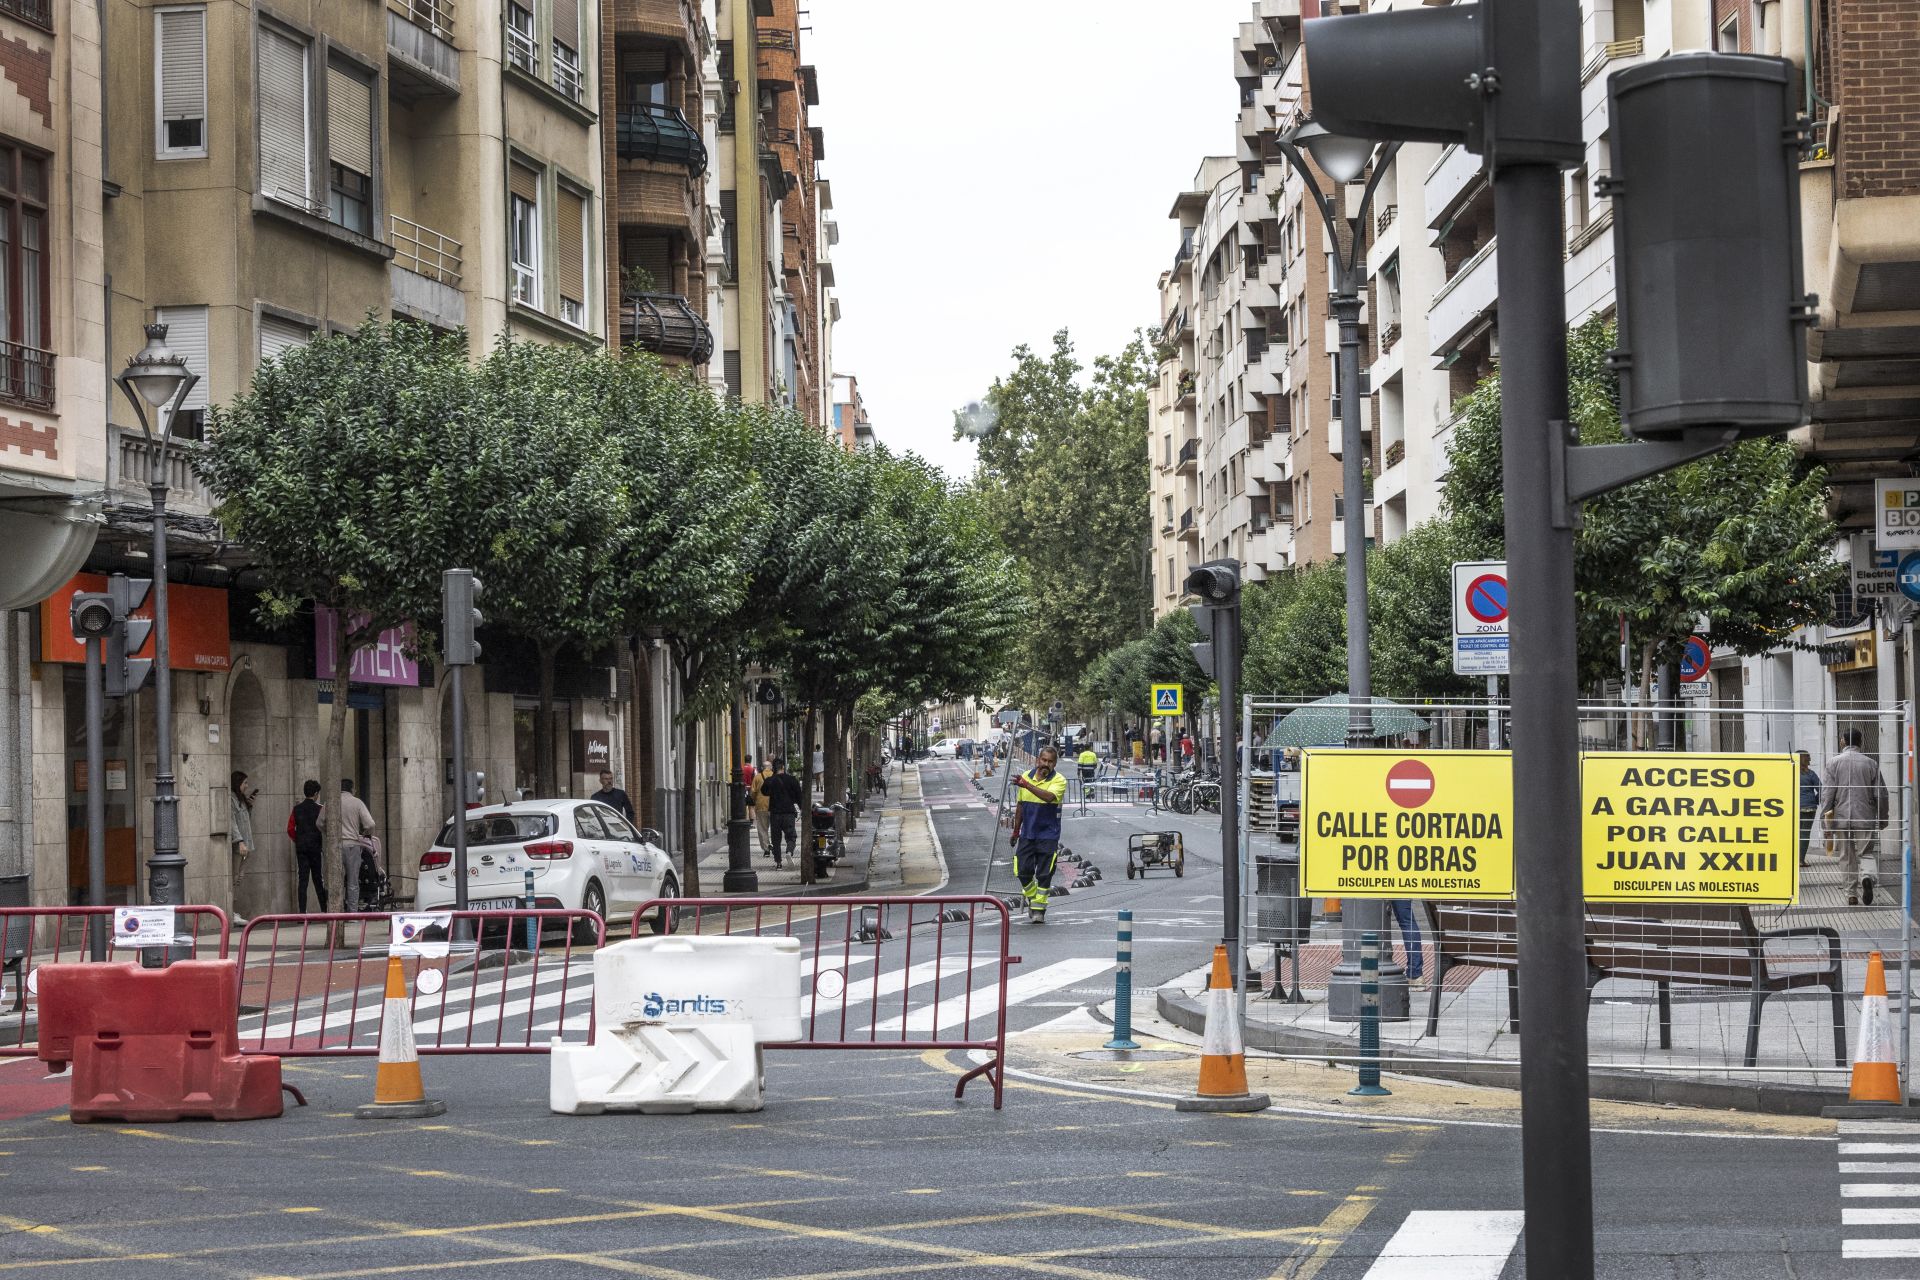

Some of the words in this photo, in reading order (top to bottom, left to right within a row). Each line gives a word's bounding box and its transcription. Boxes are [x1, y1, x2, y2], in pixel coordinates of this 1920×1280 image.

[1857, 583, 1898, 593] GUER
[1476, 625, 1503, 633] ZONA
[1621, 767, 1755, 788] ACCESO
[1591, 796, 1615, 816] A
[1626, 796, 1785, 818] GARAJES
[1317, 811, 1388, 838] CALLE
[1395, 812, 1503, 839] CORTADA
[1607, 825, 1666, 843] POR
[1677, 826, 1769, 844] CALLE
[1342, 844, 1389, 871] POR
[1397, 845, 1477, 873] OBRAS
[1597, 851, 1686, 870] JUAN
[1699, 852, 1778, 872] XXIII
[1339, 877, 1395, 888] DISCULPEN
[1399, 877, 1418, 888] LAS
[1421, 878, 1481, 889] MOLESTIAS
[1613, 880, 1672, 891] DISCULPEN
[1675, 881, 1696, 892] LAS
[1699, 881, 1760, 893] MOLESTIAS
[469, 901, 492, 911] 7761
[496, 900, 513, 910] LNX
